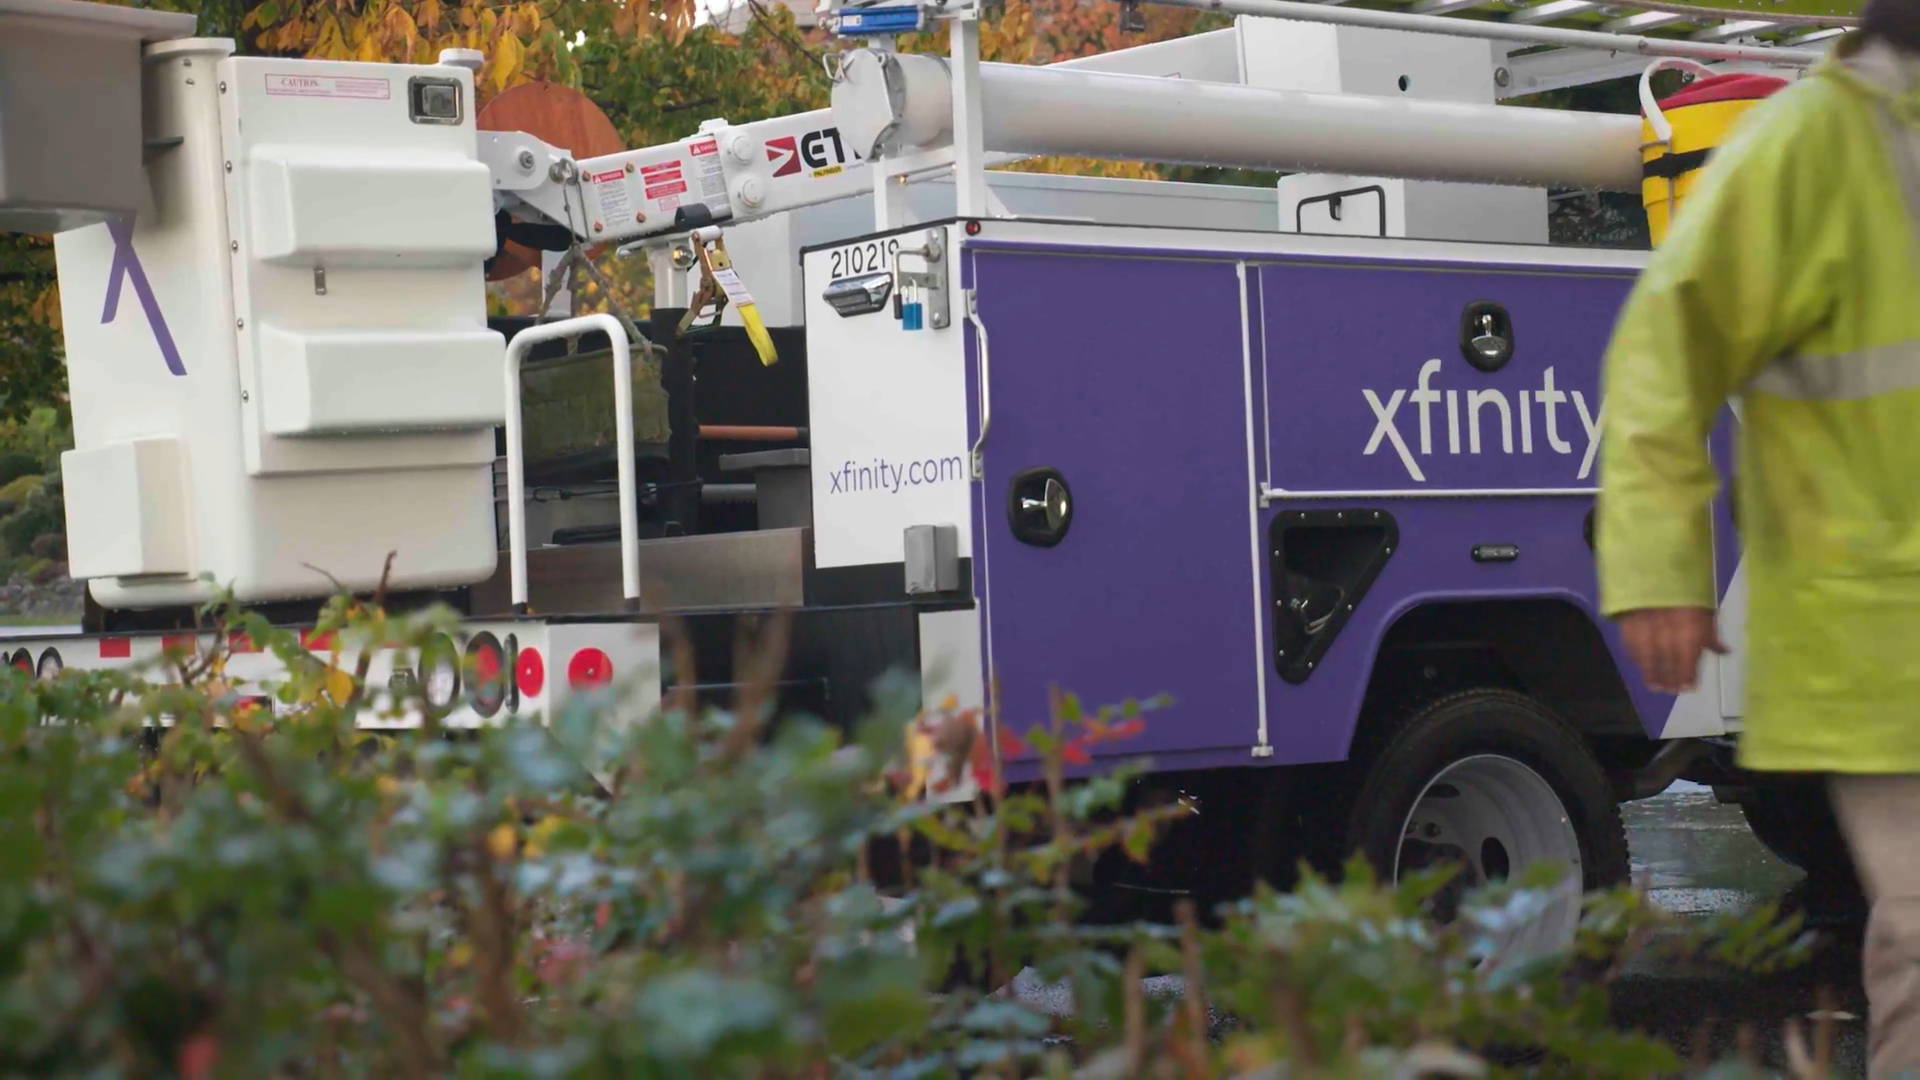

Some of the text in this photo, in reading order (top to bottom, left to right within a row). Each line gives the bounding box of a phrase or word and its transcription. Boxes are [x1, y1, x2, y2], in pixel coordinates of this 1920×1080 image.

[801, 127, 862, 168] ET
[1362, 358, 1606, 482] xfinity
[830, 456, 962, 494] xfinity.com
